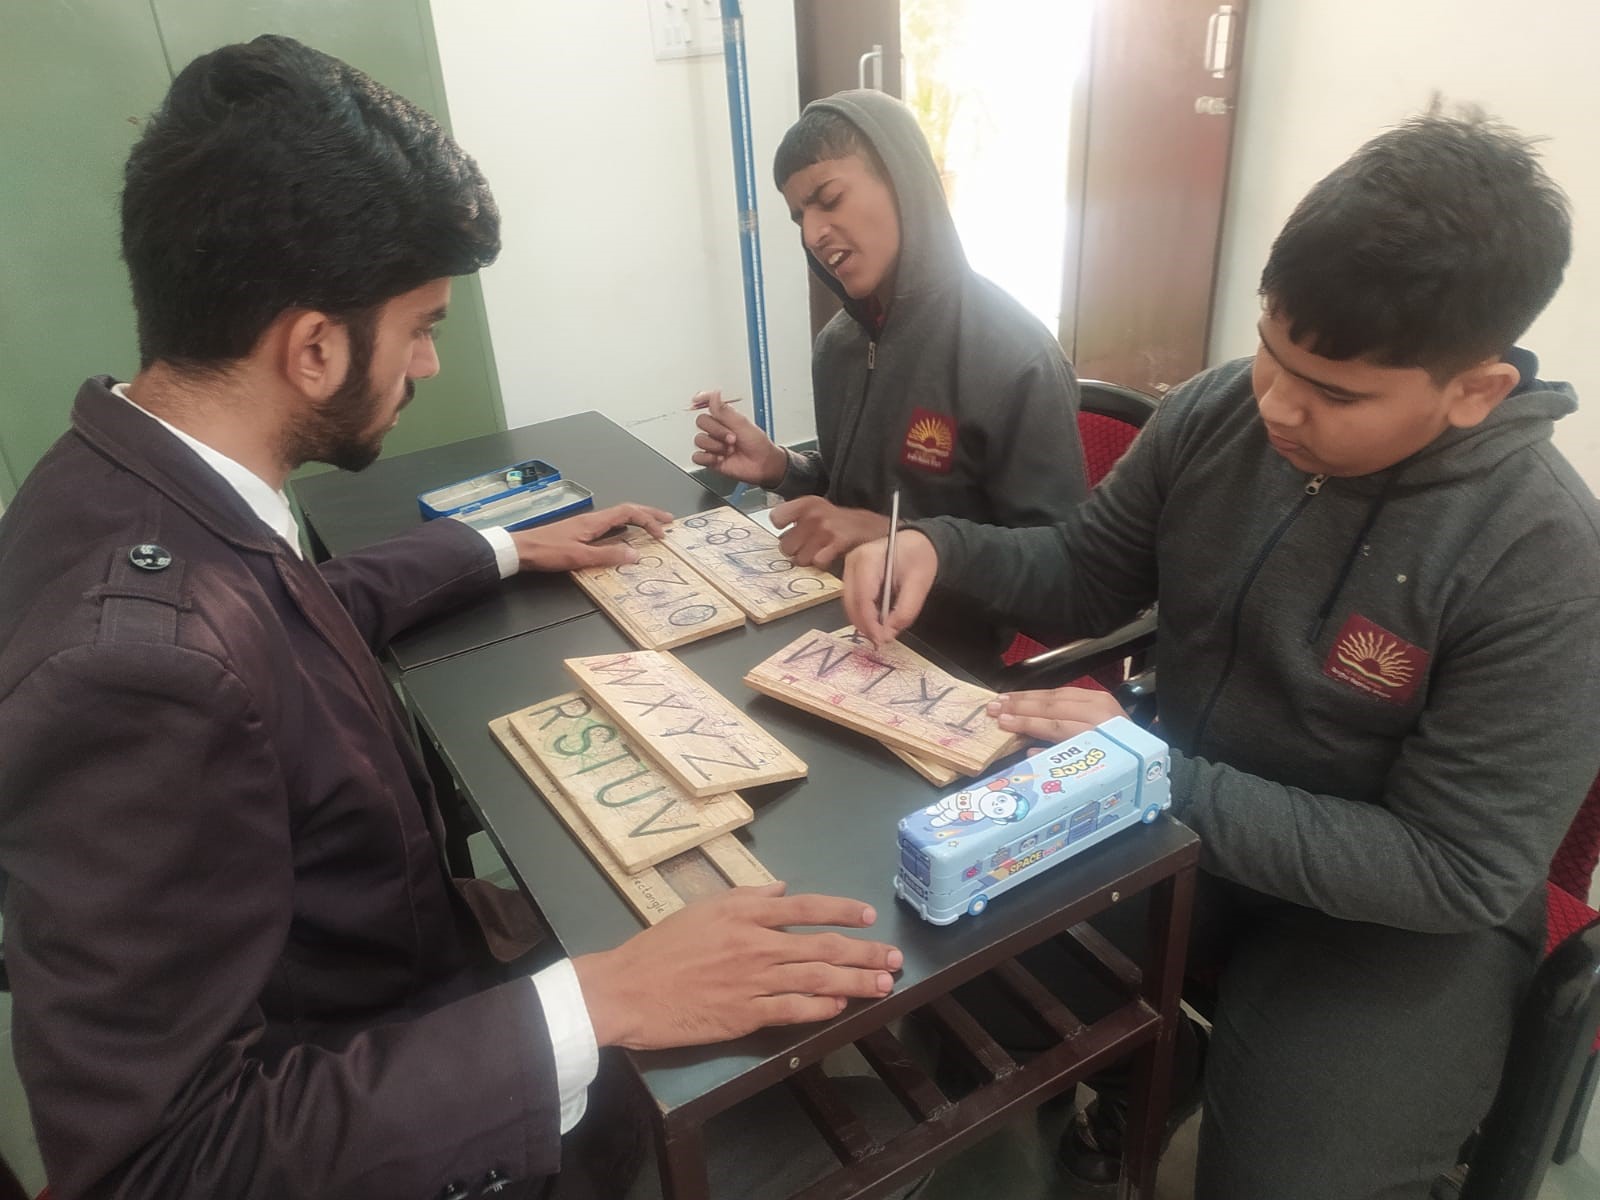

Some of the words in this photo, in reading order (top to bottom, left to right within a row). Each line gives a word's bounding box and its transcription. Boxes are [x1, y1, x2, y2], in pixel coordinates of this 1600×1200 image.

[1049, 748, 1106, 778] SPACE
[1050, 746, 1083, 764] BUS
[1009, 850, 1044, 875] SPACE
